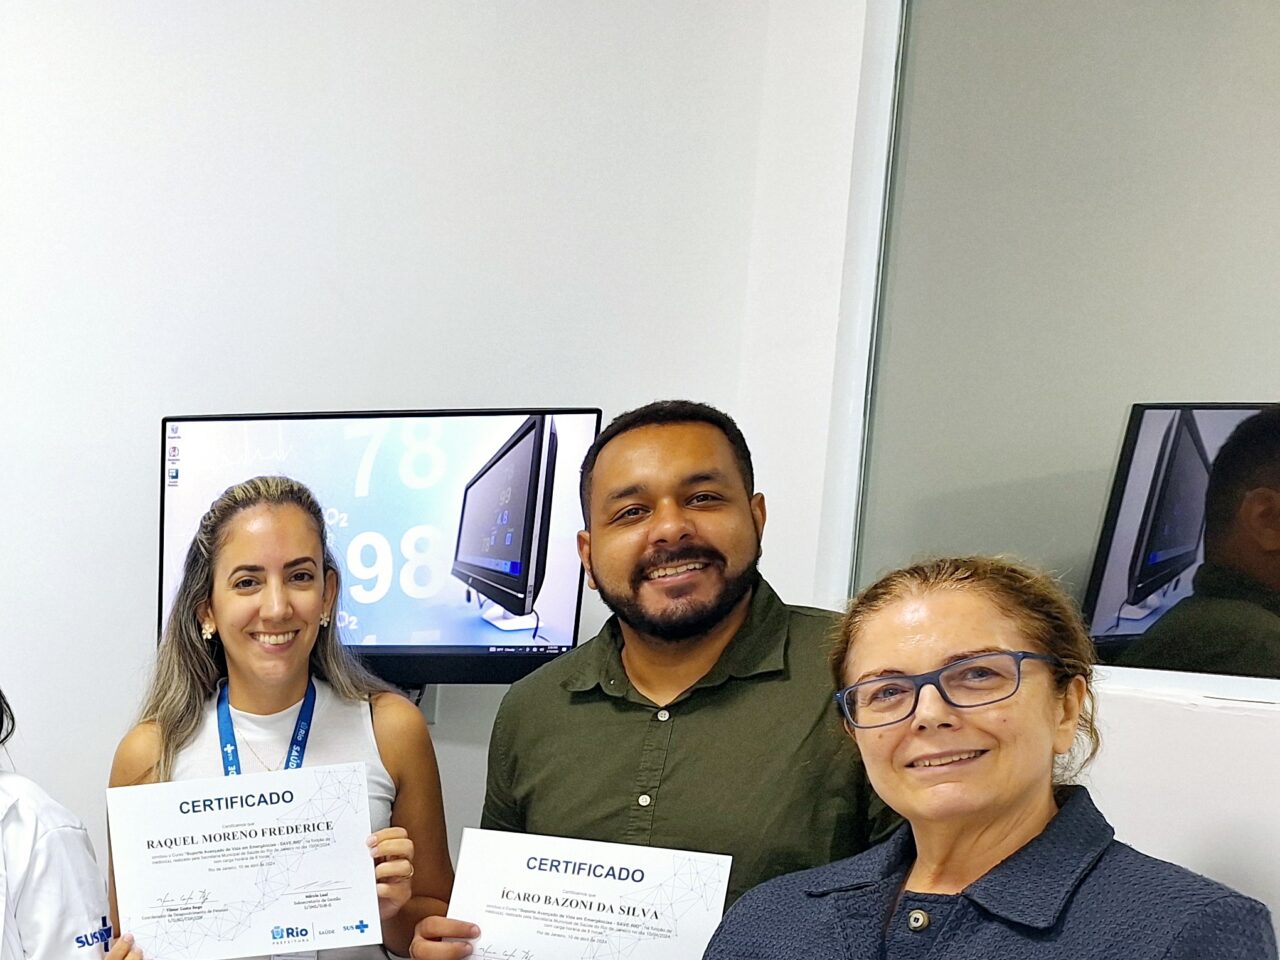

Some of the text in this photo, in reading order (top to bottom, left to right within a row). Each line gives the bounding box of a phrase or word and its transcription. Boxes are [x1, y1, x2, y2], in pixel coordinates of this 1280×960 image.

[344, 419, 447, 498] 78
[346, 525, 445, 605] 98
[288, 744, 300, 768] SAÚD
[179, 790, 294, 814] CERTIFICADO
[147, 821, 333, 848] RAQUEL MORENO FREDERICE
[526, 856, 644, 883] CERTIFICADO
[544, 896, 592, 910] BAZONI
[596, 902, 614, 913] DA
[618, 906, 658, 919] SILVA
[75, 931, 100, 949] SUS
[286, 927, 308, 938] Rio
